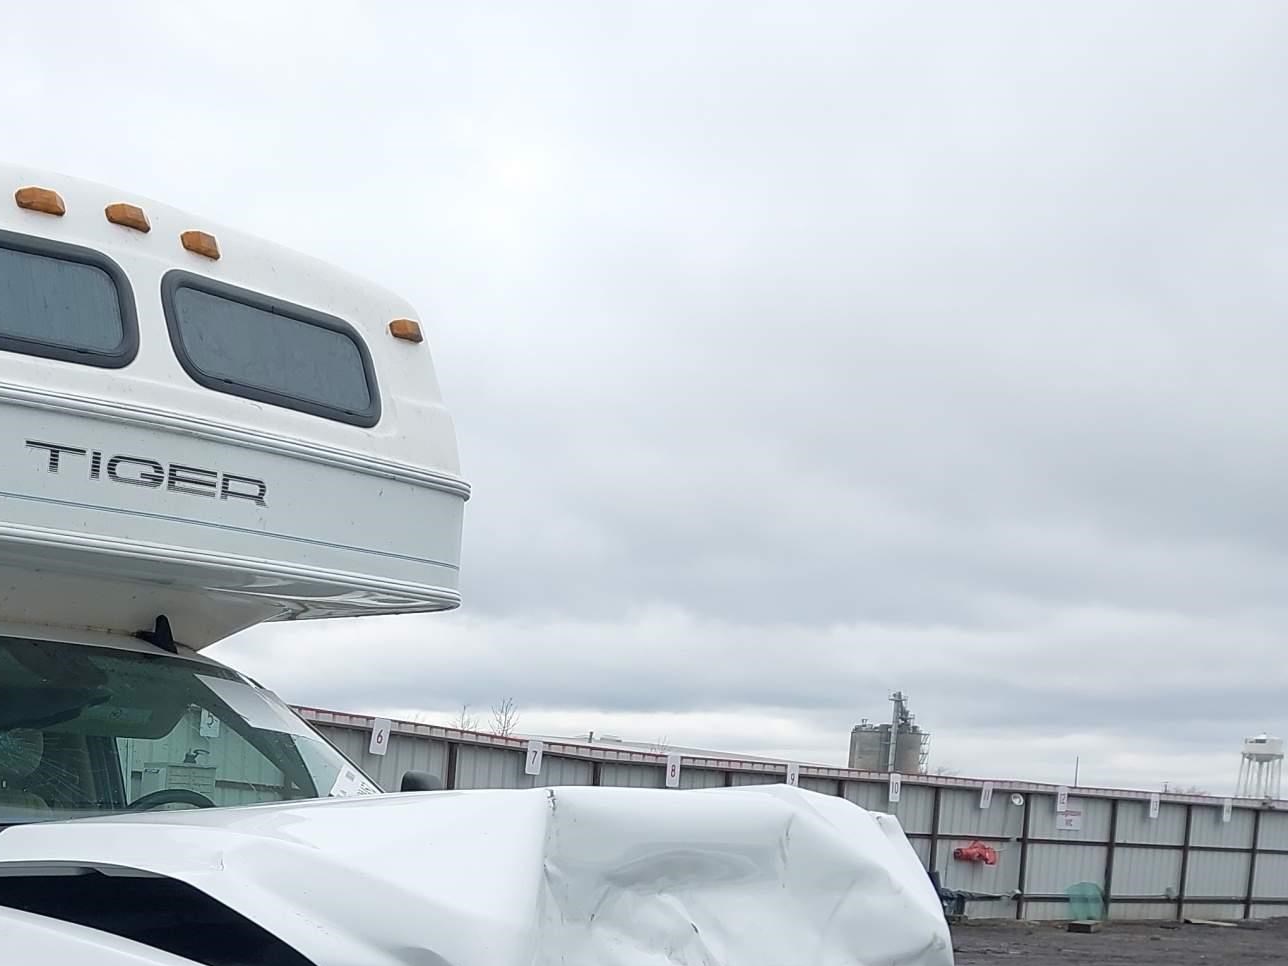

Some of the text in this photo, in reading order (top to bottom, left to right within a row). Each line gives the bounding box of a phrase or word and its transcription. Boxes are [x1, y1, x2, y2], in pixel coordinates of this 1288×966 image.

[25, 439, 268, 507] TIGER
[376, 728, 384, 745] 6
[531, 750, 538, 765] 7
[670, 764, 676, 778] 8
[891, 781, 900, 795] 10
